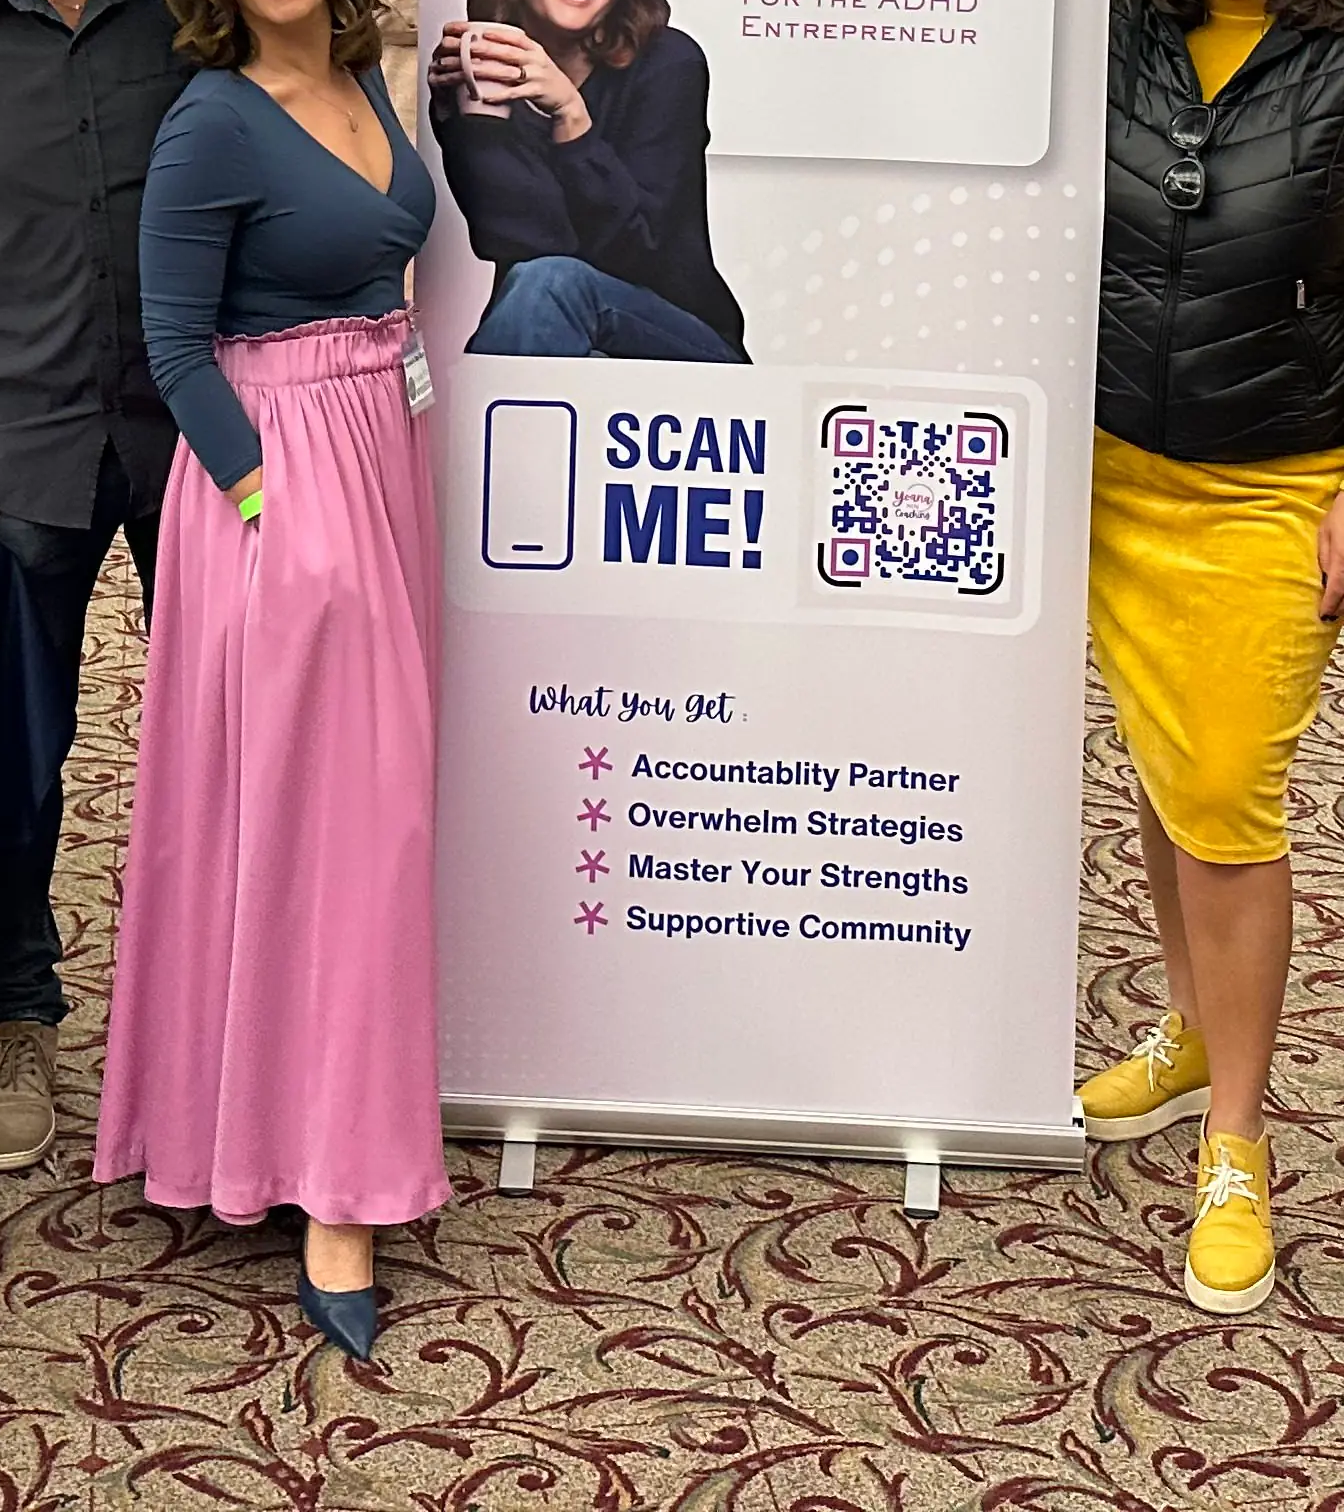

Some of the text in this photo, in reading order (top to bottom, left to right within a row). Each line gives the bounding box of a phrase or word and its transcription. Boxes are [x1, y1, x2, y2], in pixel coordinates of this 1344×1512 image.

[606, 412, 766, 474] SCAN
[602, 482, 765, 569] ME!
[529, 683, 614, 717] What
[631, 753, 960, 793] Accountablity Partner
[628, 802, 963, 845] Overwhelm Strategies
[629, 854, 969, 897] Master Your Strengths
[626, 905, 972, 952] Supportive Community
